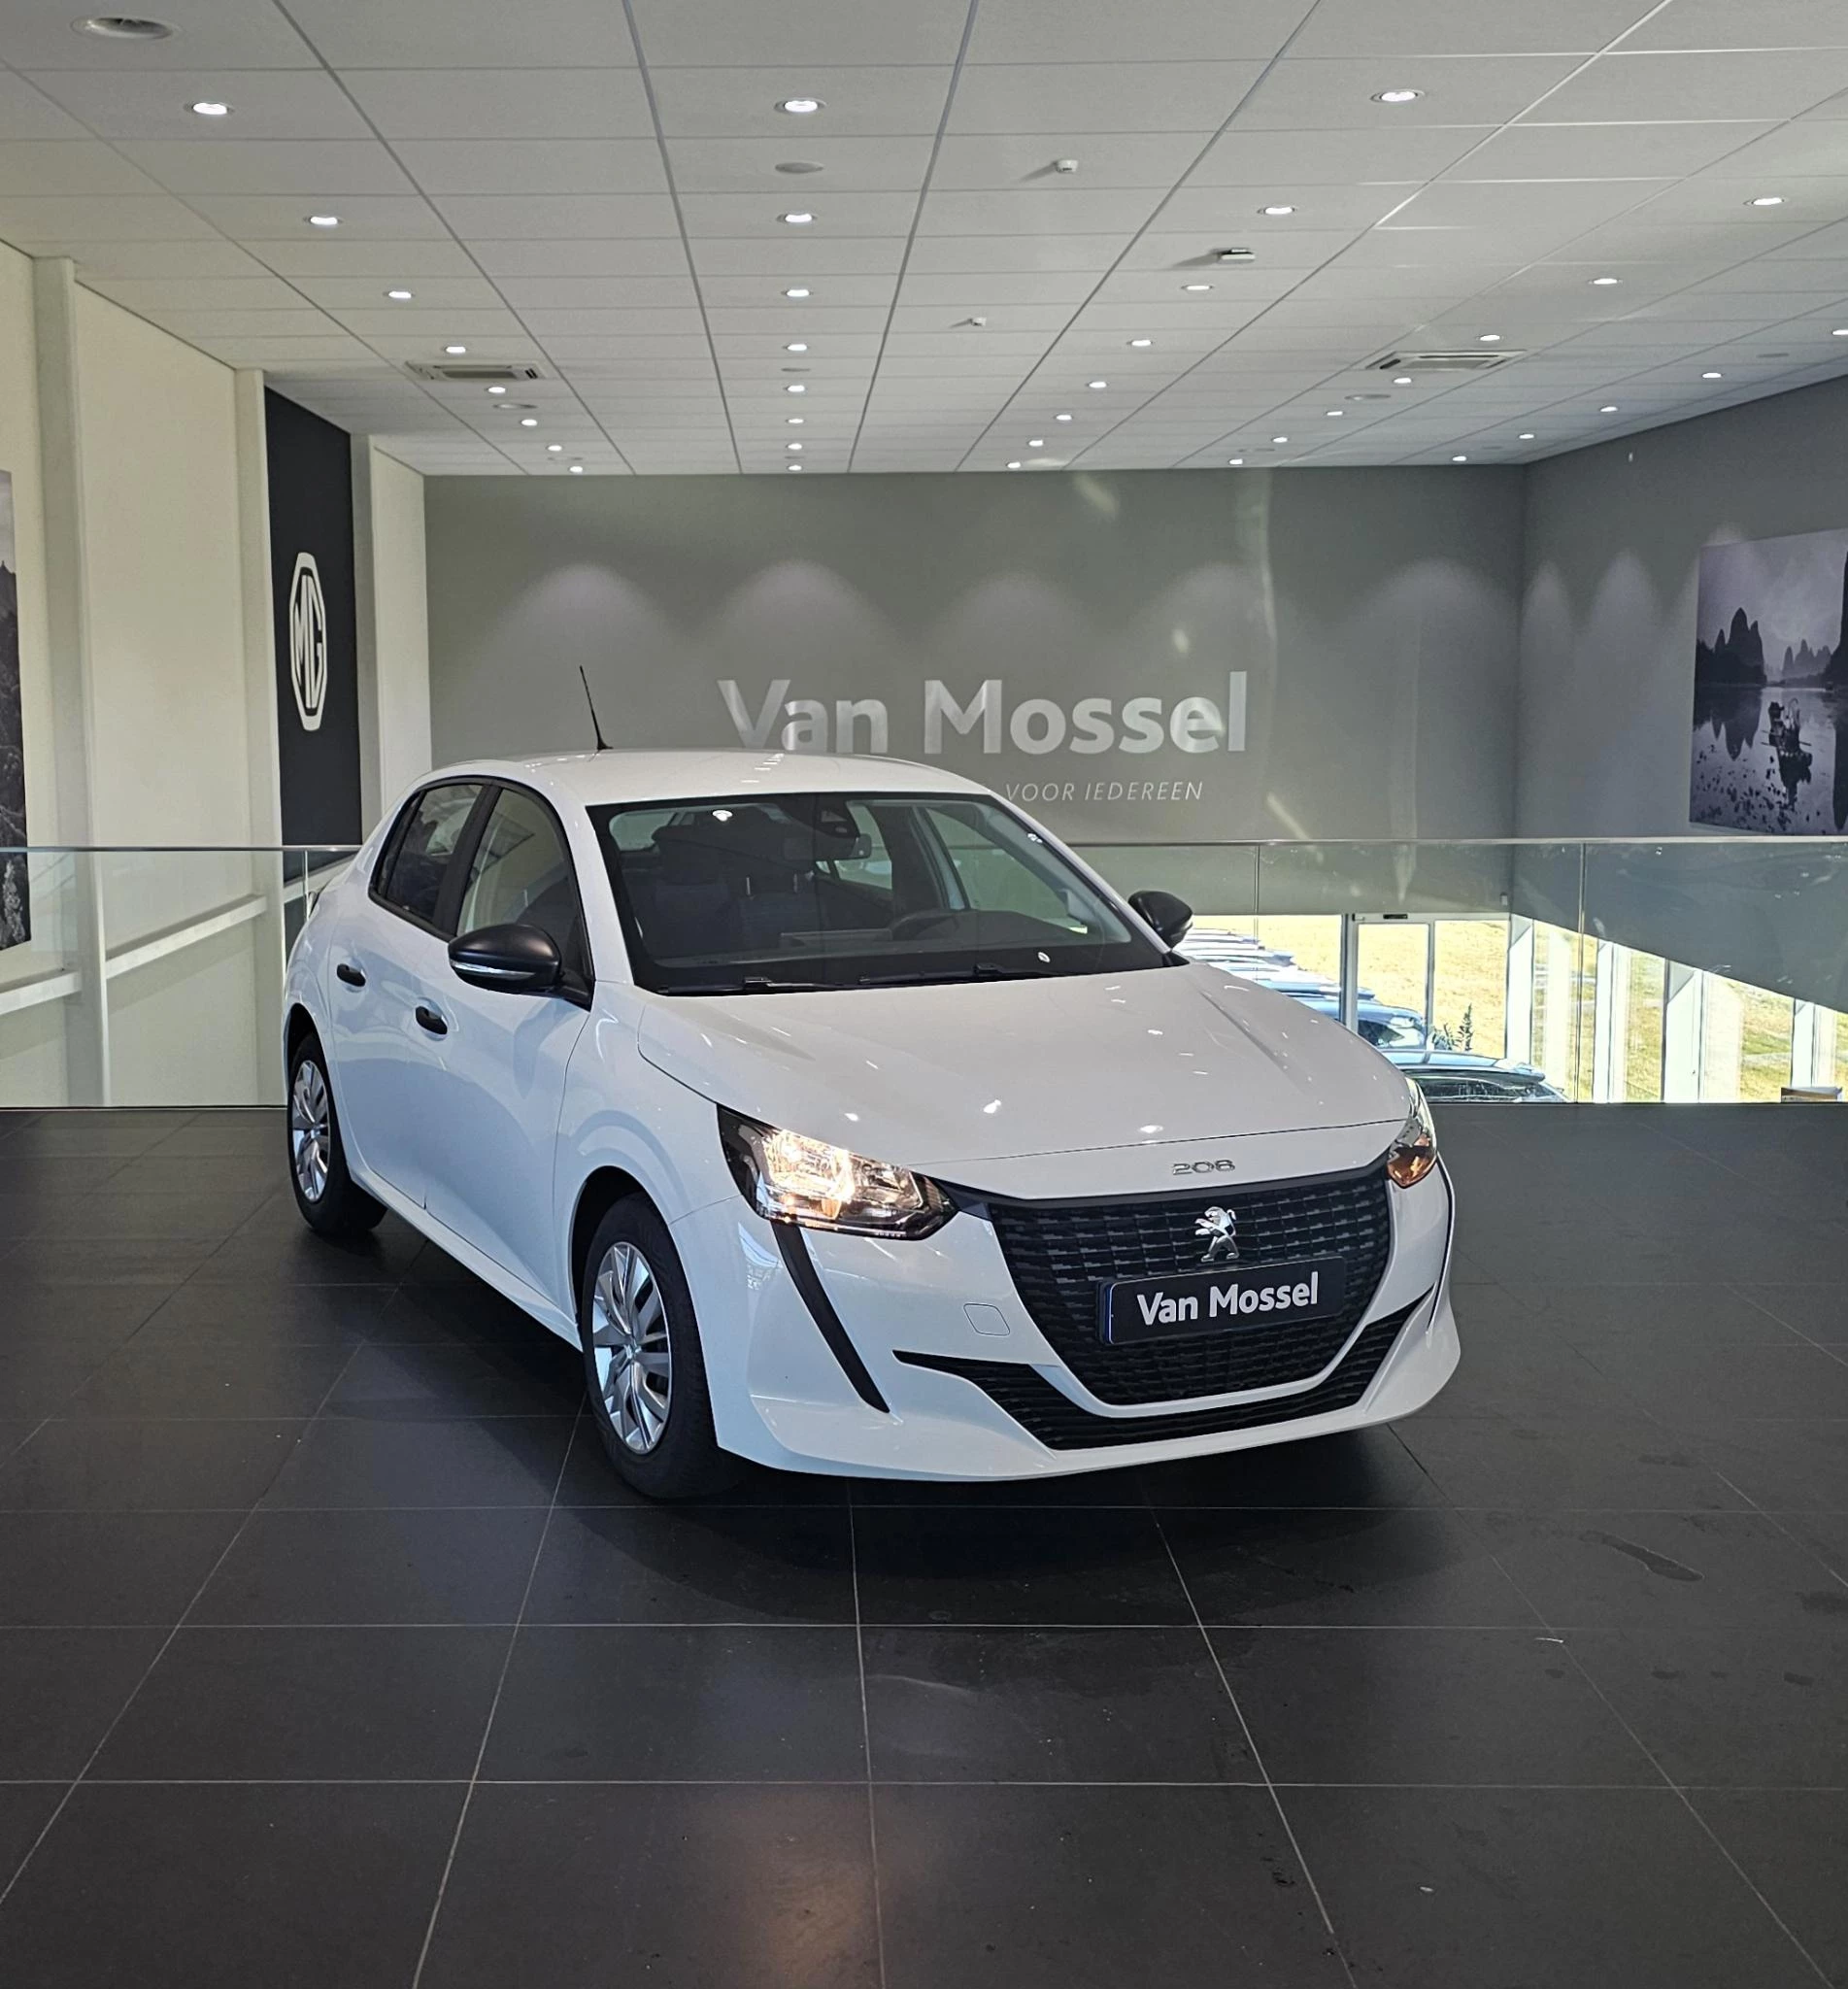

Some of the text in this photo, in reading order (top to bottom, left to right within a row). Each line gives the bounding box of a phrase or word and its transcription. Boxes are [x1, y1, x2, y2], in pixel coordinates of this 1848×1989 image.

[294, 575, 323, 709] MG
[717, 671, 1248, 754] Van Mossel
[1005, 781, 1203, 802] VOOR IEDEREEN
[1172, 1159, 1235, 1175] 208
[1137, 1271, 1319, 1326] Van Mossel
